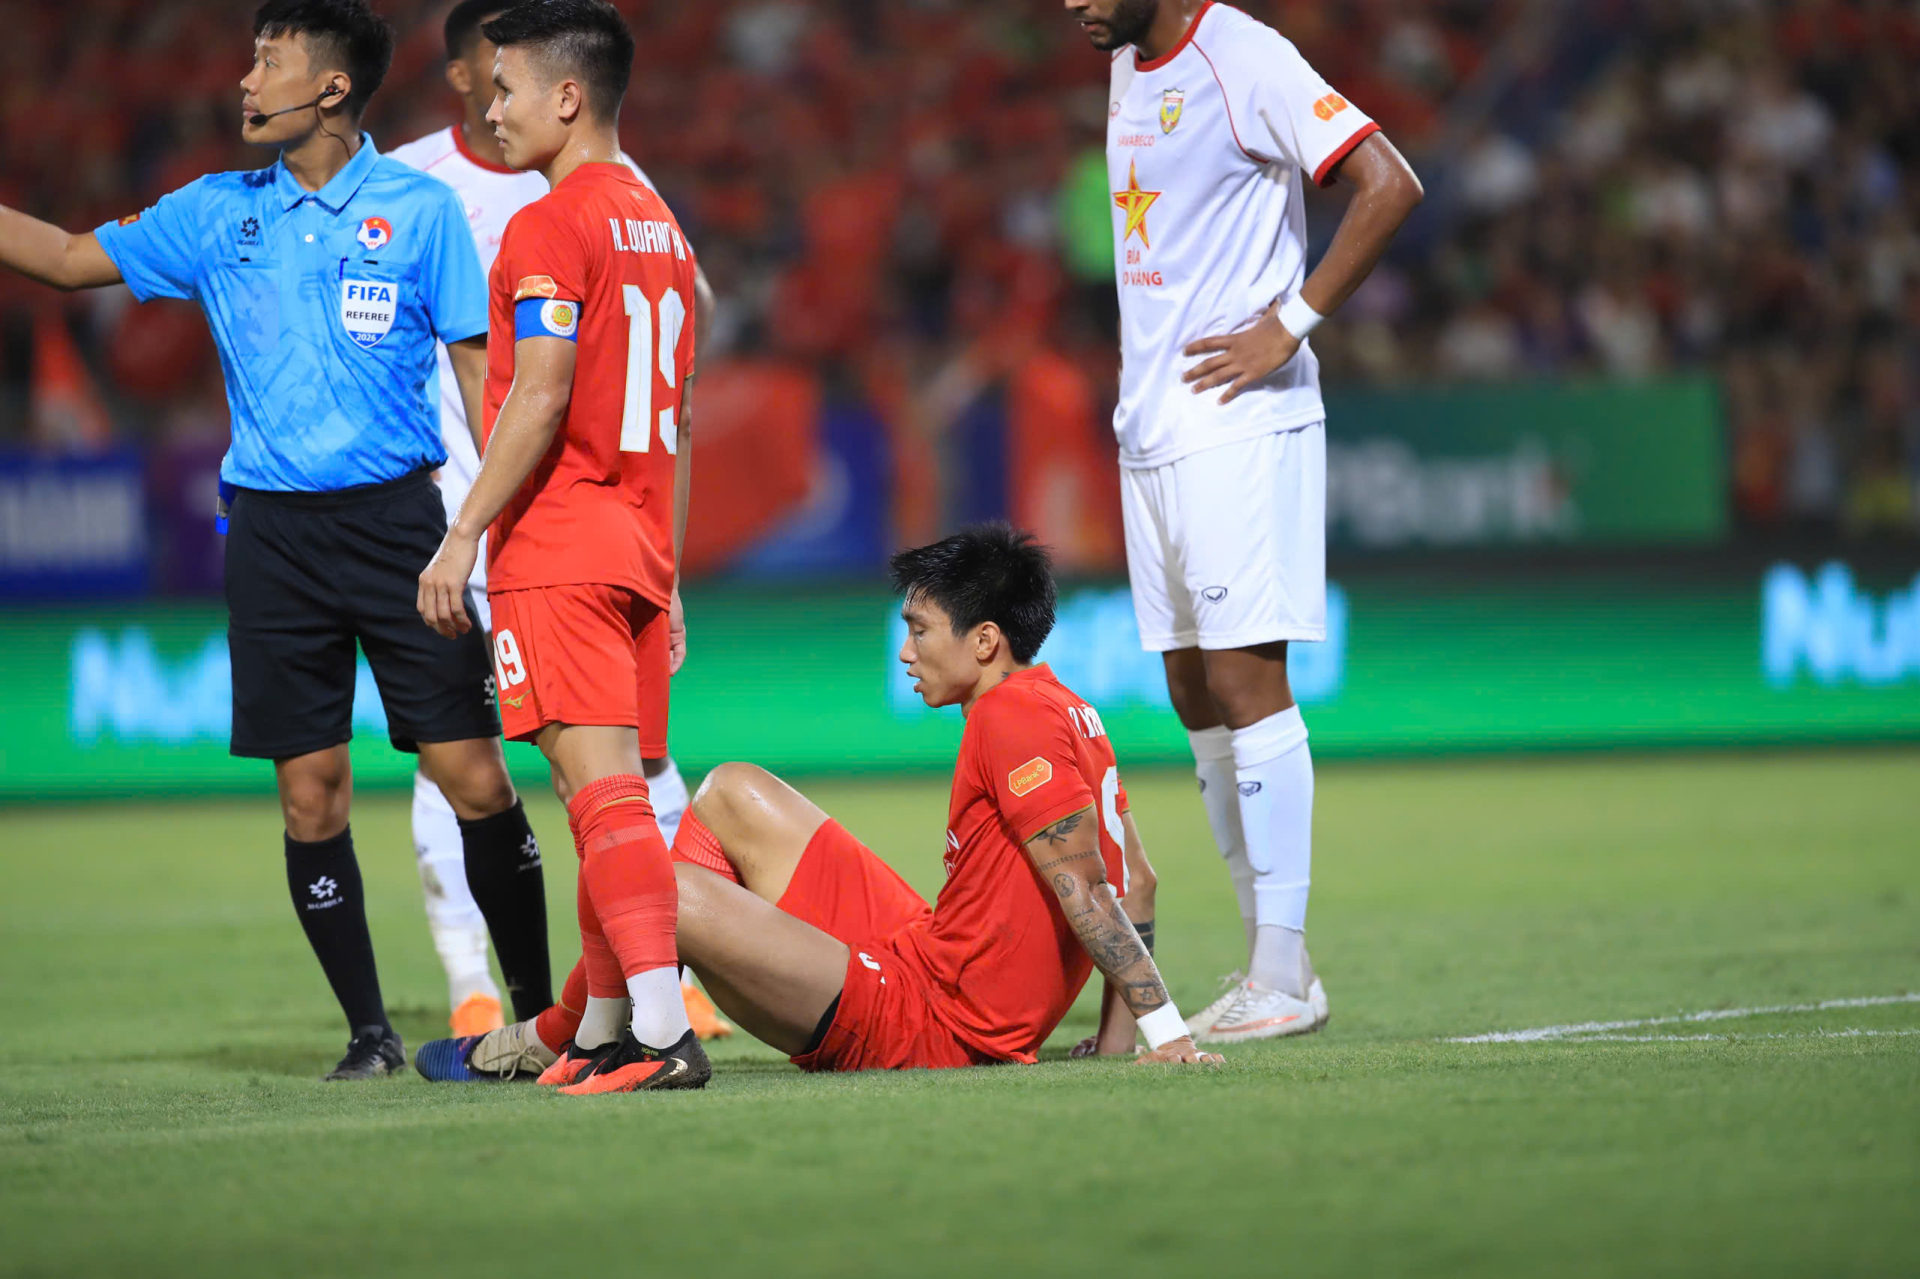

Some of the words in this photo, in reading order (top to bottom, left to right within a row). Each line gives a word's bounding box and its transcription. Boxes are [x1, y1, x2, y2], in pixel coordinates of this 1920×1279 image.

[347, 285, 391, 303] FIFA
[346, 310, 390, 322] REFEREE
[356, 332, 377, 342] 2026
[620, 284, 685, 455] 19
[493, 628, 527, 691] 19
[1013, 770, 1040, 790] LPBank
